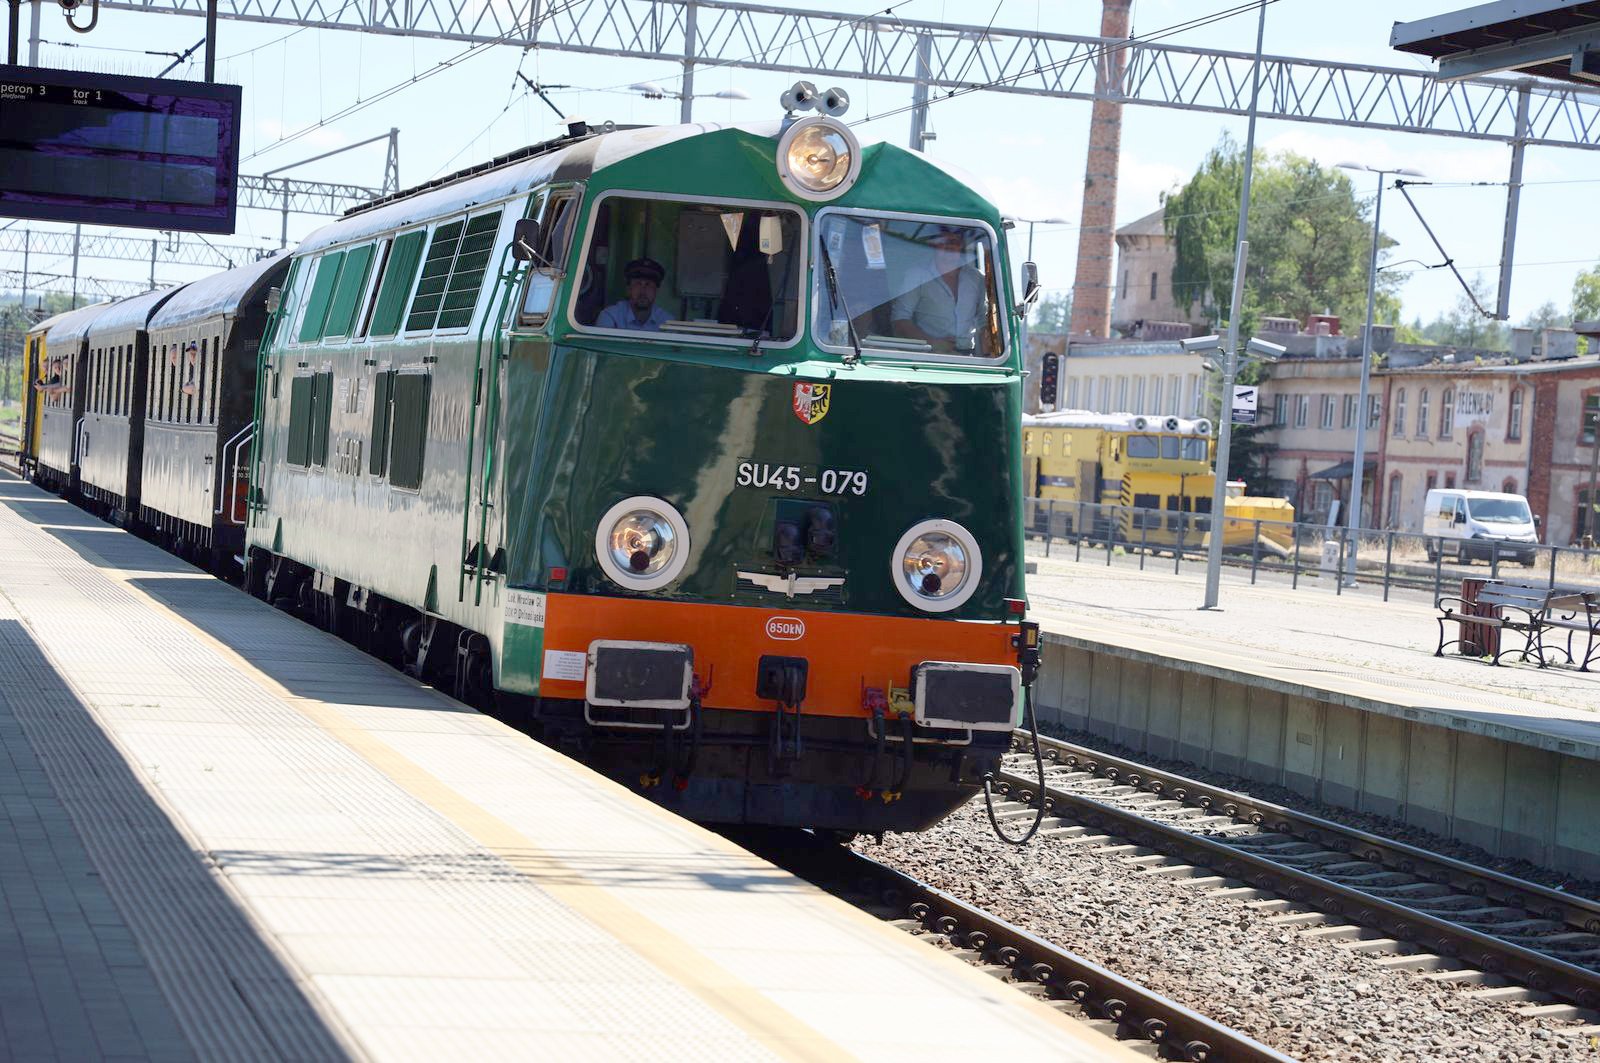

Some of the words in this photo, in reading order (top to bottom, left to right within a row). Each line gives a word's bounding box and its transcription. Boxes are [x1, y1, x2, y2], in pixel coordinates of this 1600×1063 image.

[0, 84, 33, 94] peron
[39, 85, 46, 95] 3
[73, 89, 90, 99] tor
[95, 90, 102, 100] 1
[736, 462, 868, 496] SU45-079
[769, 622, 802, 635] 850kN
